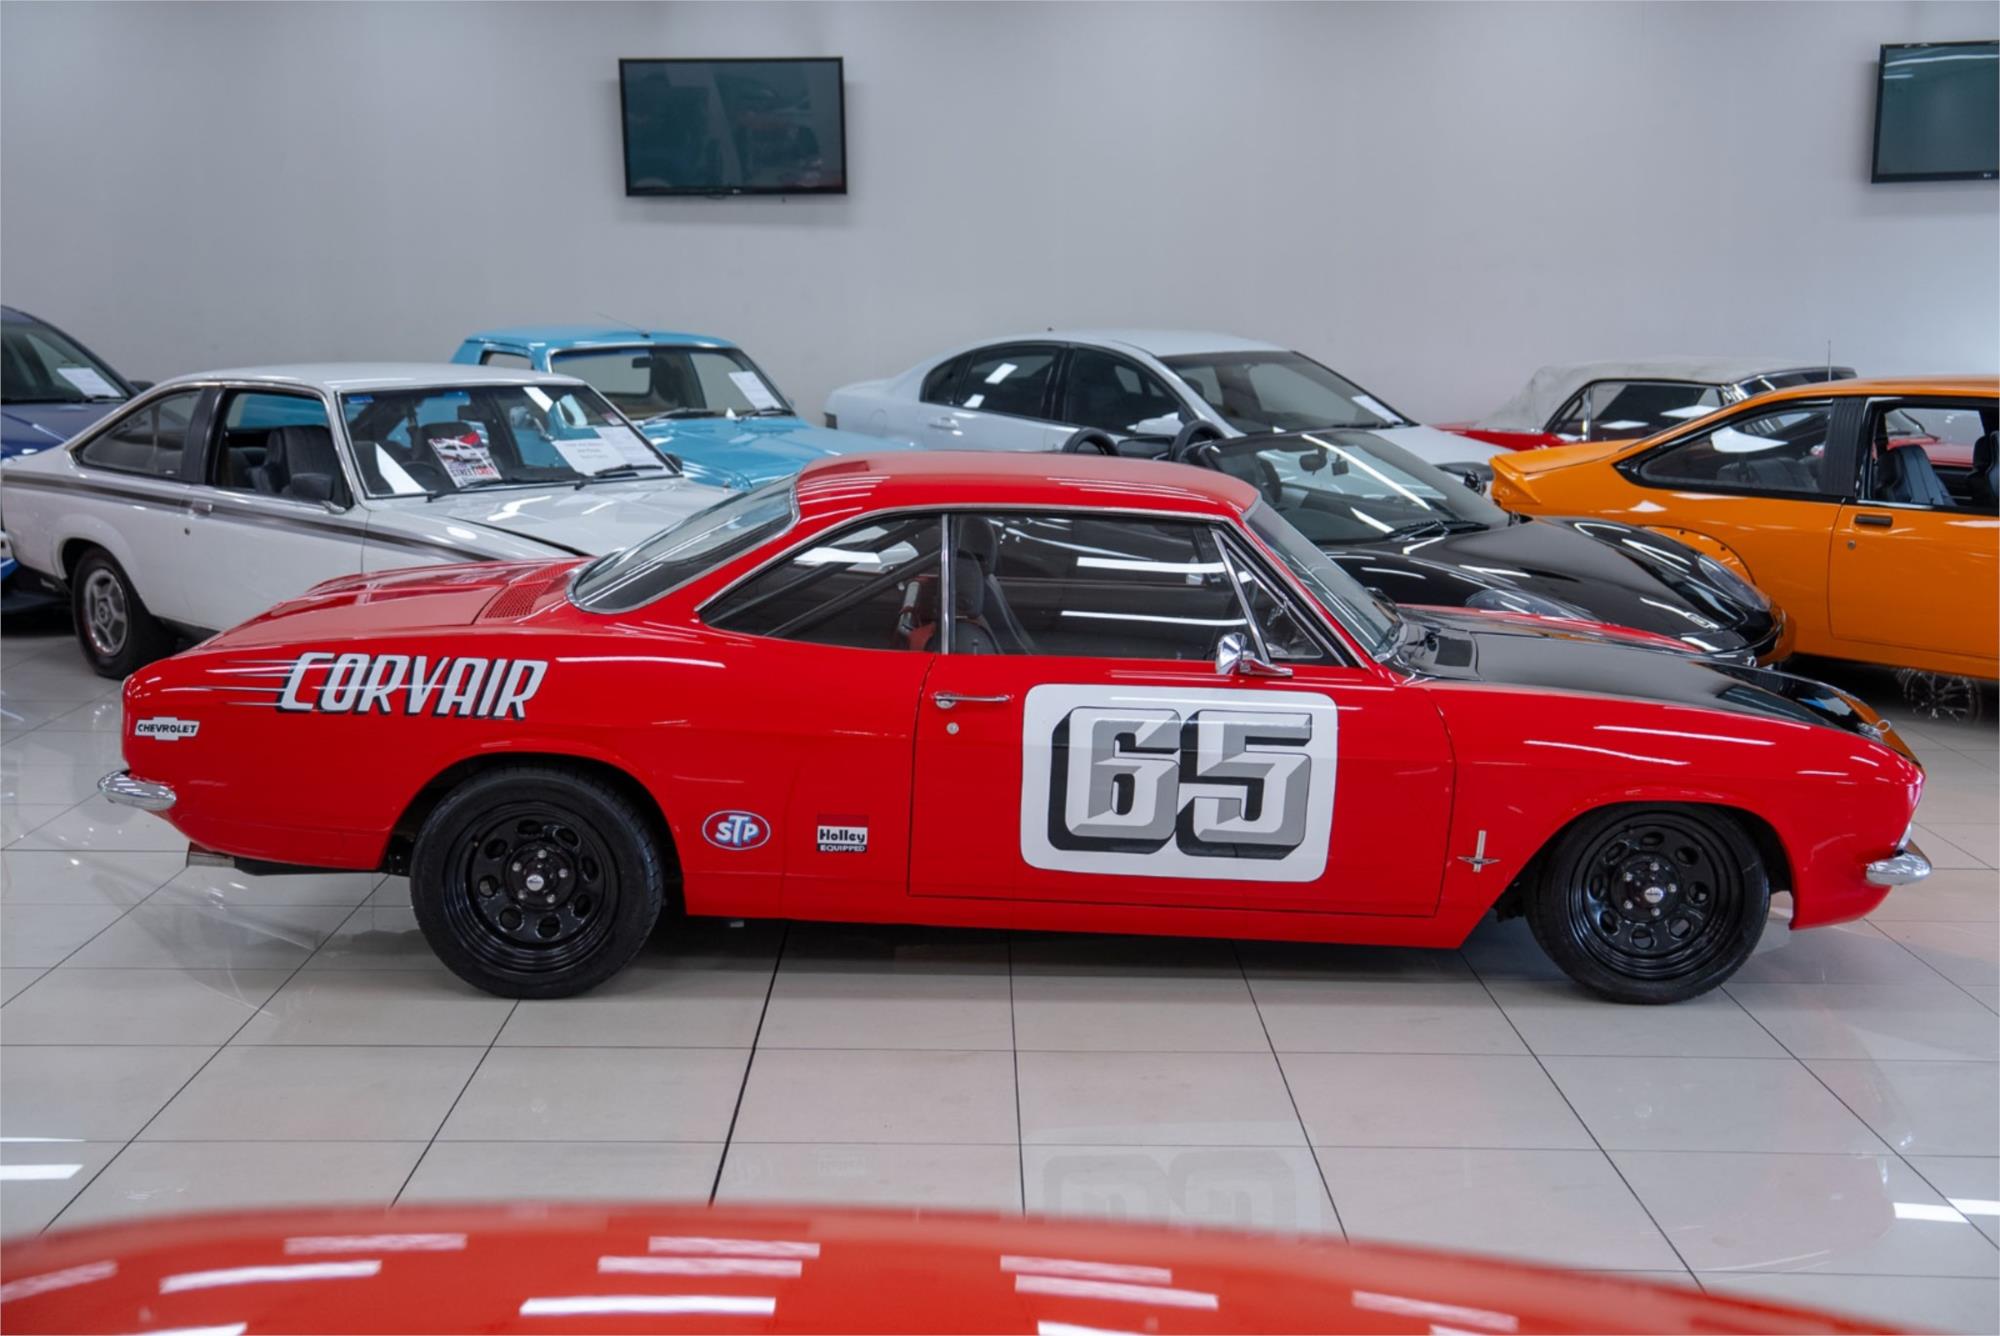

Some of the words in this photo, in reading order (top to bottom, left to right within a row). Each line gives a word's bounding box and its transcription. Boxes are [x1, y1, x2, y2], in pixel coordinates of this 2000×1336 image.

[276, 651, 549, 720] CORVAIR
[137, 723, 197, 734] CHEVROLET
[1047, 705, 1313, 860] 65
[714, 814, 760, 846] STP
[819, 828, 866, 843] Holley
[819, 844, 866, 852] EQUIPPED
